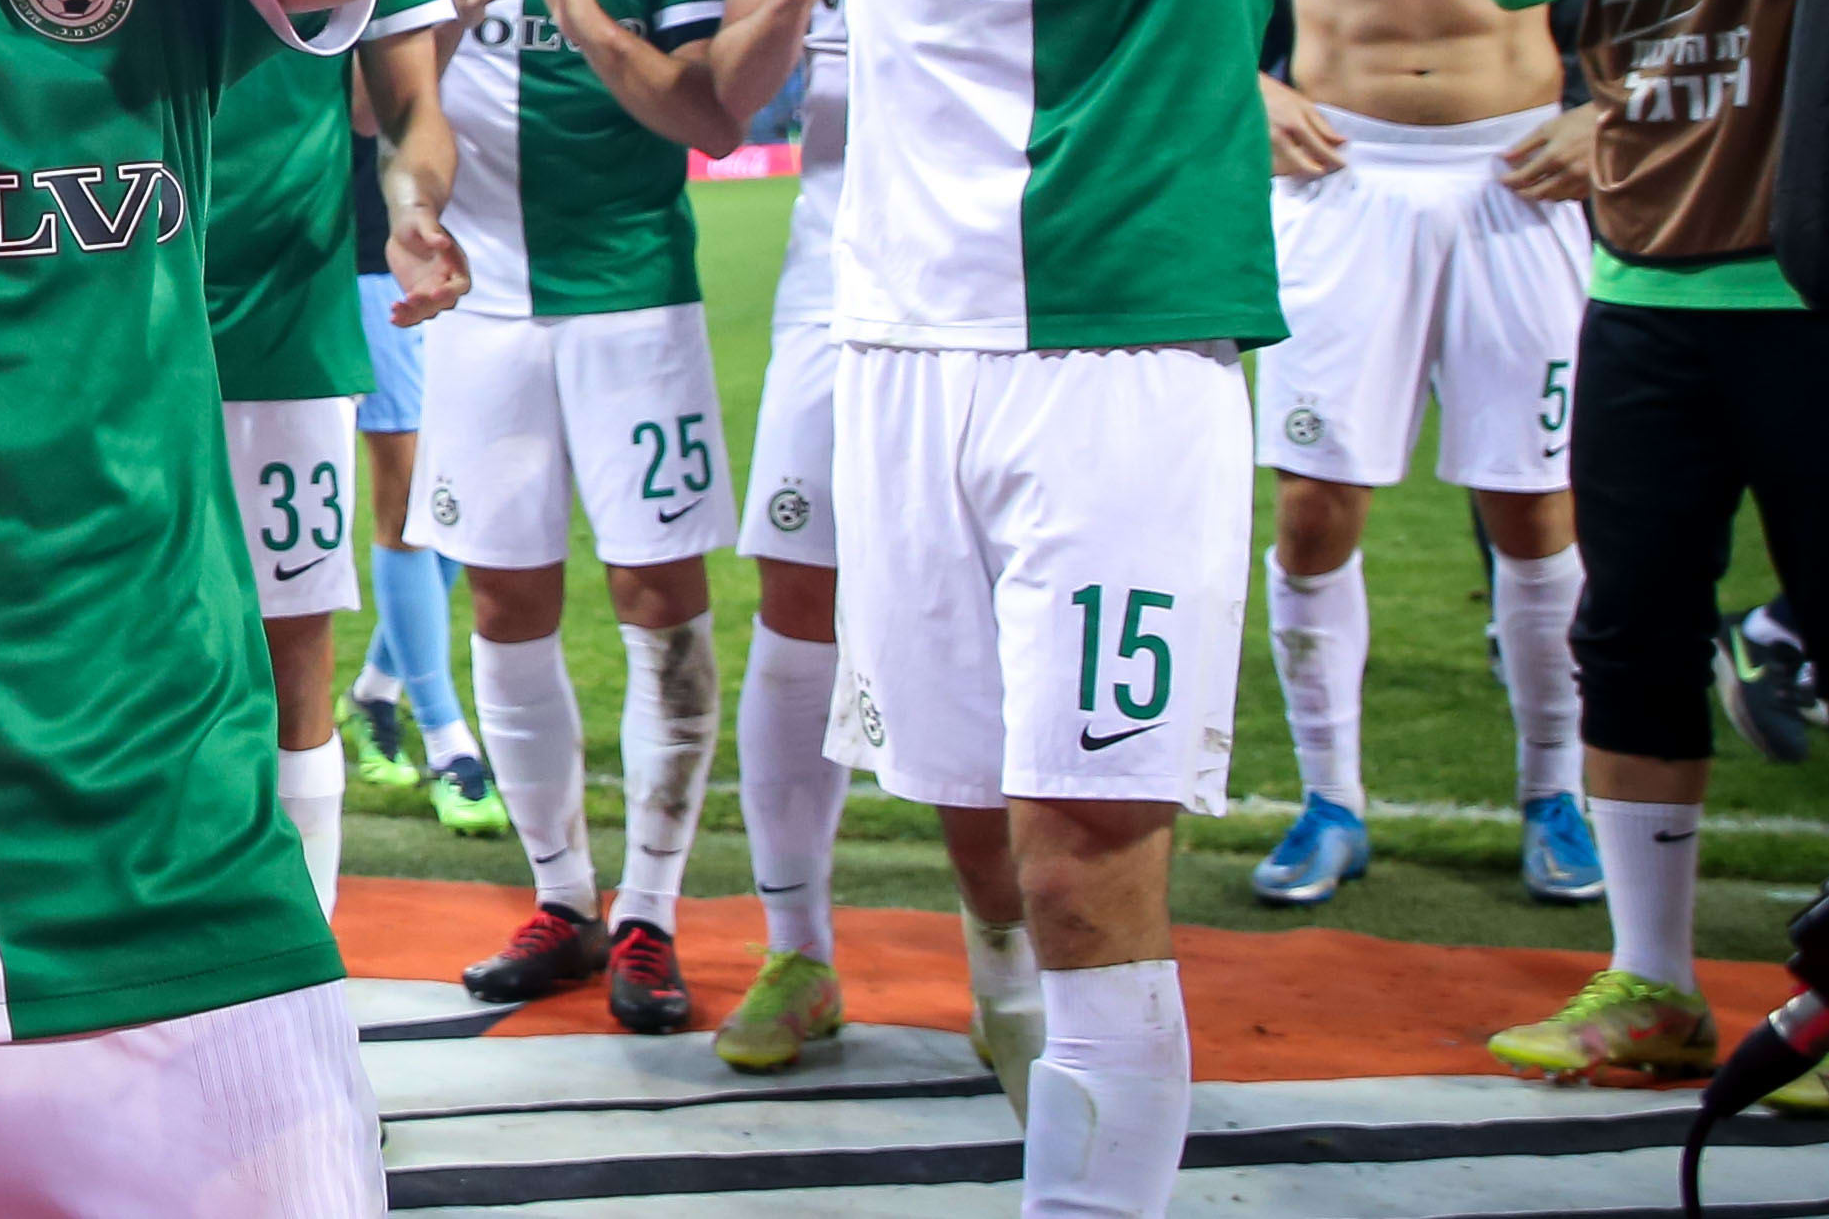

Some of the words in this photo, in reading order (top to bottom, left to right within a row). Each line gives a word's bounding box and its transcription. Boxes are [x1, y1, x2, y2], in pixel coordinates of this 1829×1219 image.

[1539, 360, 1569, 432] 5
[632, 413, 712, 500] 25
[260, 461, 343, 551] 33
[1072, 584, 1175, 720] 15
